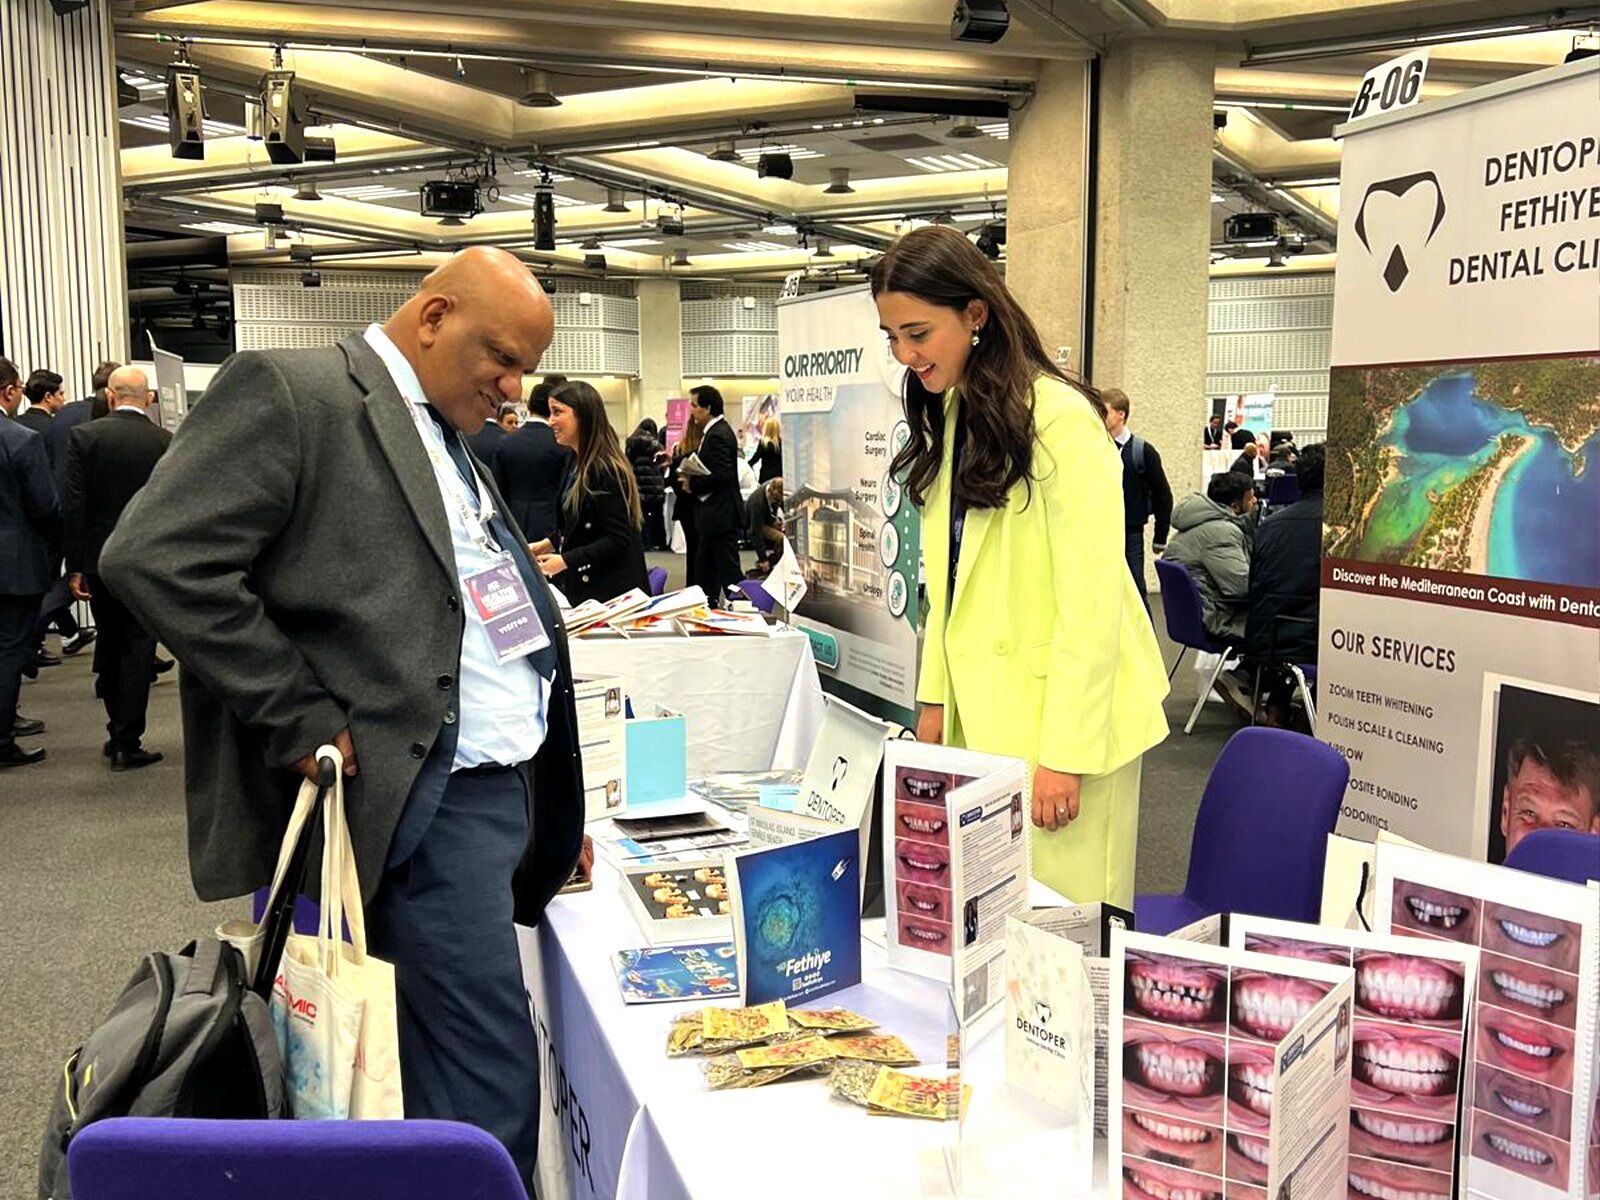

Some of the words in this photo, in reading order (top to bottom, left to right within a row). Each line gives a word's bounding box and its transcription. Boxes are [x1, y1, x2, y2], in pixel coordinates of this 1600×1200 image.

[1351, 60, 1423, 118] B-06
[1485, 137, 1600, 186] DENTOP
[1450, 247, 1543, 285] DENTAL
[785, 355, 809, 378] OUR
[810, 347, 864, 376] PRIORITY
[786, 388, 805, 402] YOUR
[806, 386, 832, 401] HEALTH
[865, 431, 886, 442] Cardiac
[865, 445, 886, 457] Surgery
[855, 491, 877, 504] Surgery
[1332, 568, 1376, 586] Discover
[1379, 573, 1399, 589] the
[1401, 576, 1485, 601] Mediterranean
[1487, 587, 1526, 606] Coast
[1528, 594, 1556, 611] with
[1331, 629, 1365, 655] OUR
[1371, 635, 1456, 673] SERVICES
[1329, 683, 1355, 699] ZOOM
[1356, 690, 1383, 706] TEETH
[1384, 696, 1434, 719] WHITENING
[1328, 712, 1356, 730] POLISH
[1357, 720, 1387, 738] SCALE
[1395, 731, 1445, 754] CLEANING
[807, 791, 846, 825] DENTOPER
[1376, 786, 1419, 810] BONDING
[785, 949, 832, 977] Fethiye
[1016, 1017, 1066, 1050] DENTOPER
